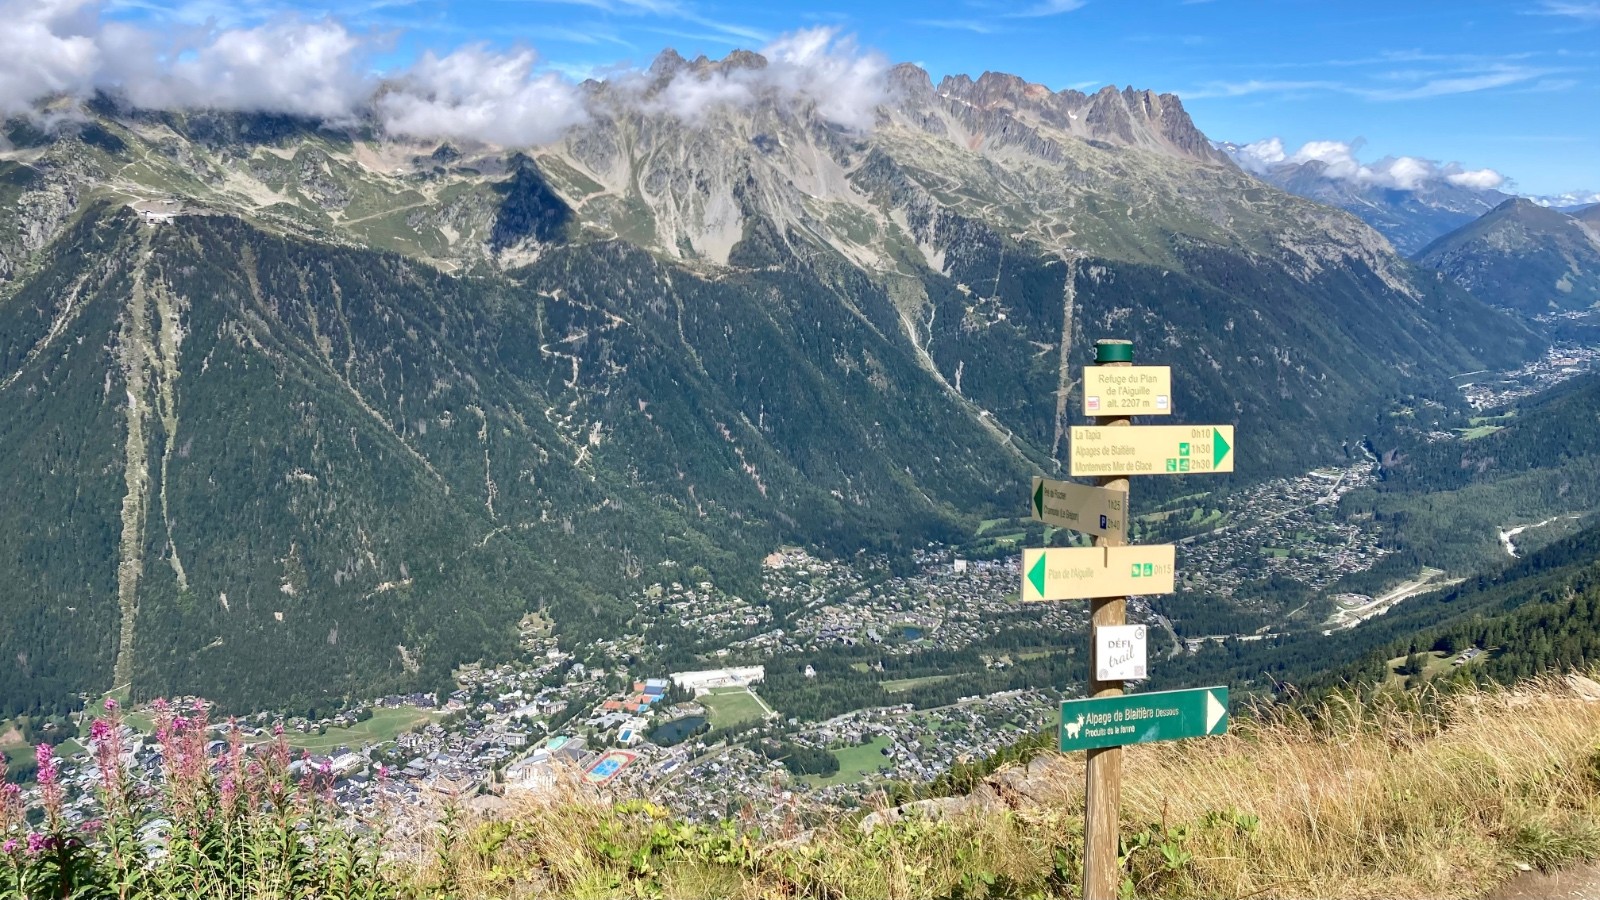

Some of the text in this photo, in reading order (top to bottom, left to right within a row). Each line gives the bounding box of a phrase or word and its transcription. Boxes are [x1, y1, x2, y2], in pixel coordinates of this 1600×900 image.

[1098, 374, 1158, 385] Refuge du Plan
[1106, 386, 1150, 397] de l'Aiguille
[1107, 399, 1119, 408] alt.
[1121, 399, 1141, 408] 2207
[1075, 428, 1210, 441] La Tapia 0h10
[1075, 446, 1100, 458] Alpages
[1102, 446, 1110, 456] de
[1191, 444, 1210, 454] 1h30
[1075, 460, 1210, 472] Montenvers Mer de Glace 2h30
[1048, 564, 1172, 580] Plan de l'Aiguille 0h15
[1108, 637, 1130, 648] DÉFI
[1109, 644, 1134, 668] trail
[1086, 707, 1180, 726] Alpage de Blaitière Dessous
[1085, 728, 1106, 738] Produits
